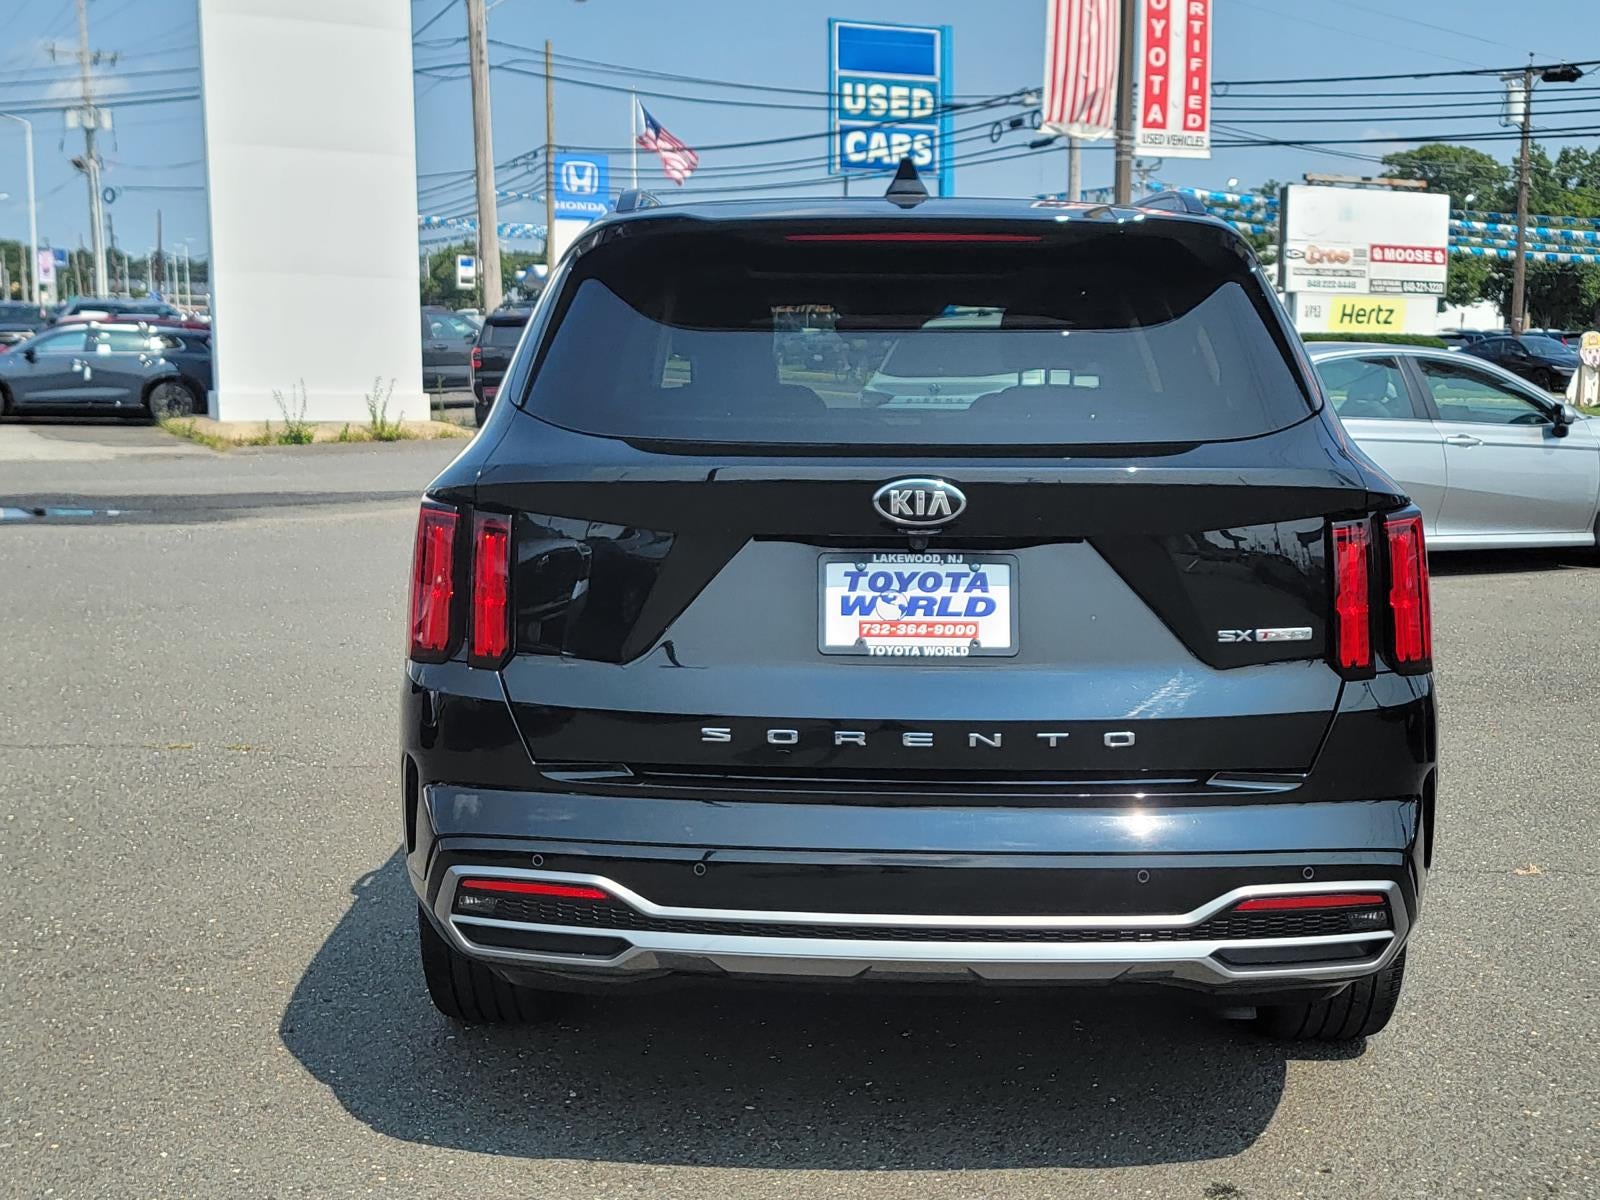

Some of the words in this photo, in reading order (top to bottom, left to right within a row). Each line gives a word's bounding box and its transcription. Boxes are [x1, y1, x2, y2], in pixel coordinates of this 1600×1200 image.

[843, 82, 934, 118] USED
[1142, 133, 1165, 145] USED
[1166, 134, 1205, 147] VEHICLES
[845, 131, 932, 166] CARS
[554, 200, 606, 211] HONDA
[1383, 247, 1433, 263] MOOSE
[1340, 304, 1395, 325] Hertz
[889, 489, 952, 516] KIA
[873, 554, 944, 565] LAKEWOOD,
[947, 555, 963, 564] NJ
[843, 571, 990, 593] TOYOTA
[861, 623, 976, 635] 732-364-9000
[1218, 630, 1253, 642] SX
[868, 645, 921, 656] TOYOTA
[923, 646, 969, 656] WORLD
[701, 727, 1136, 748] SORENTO
